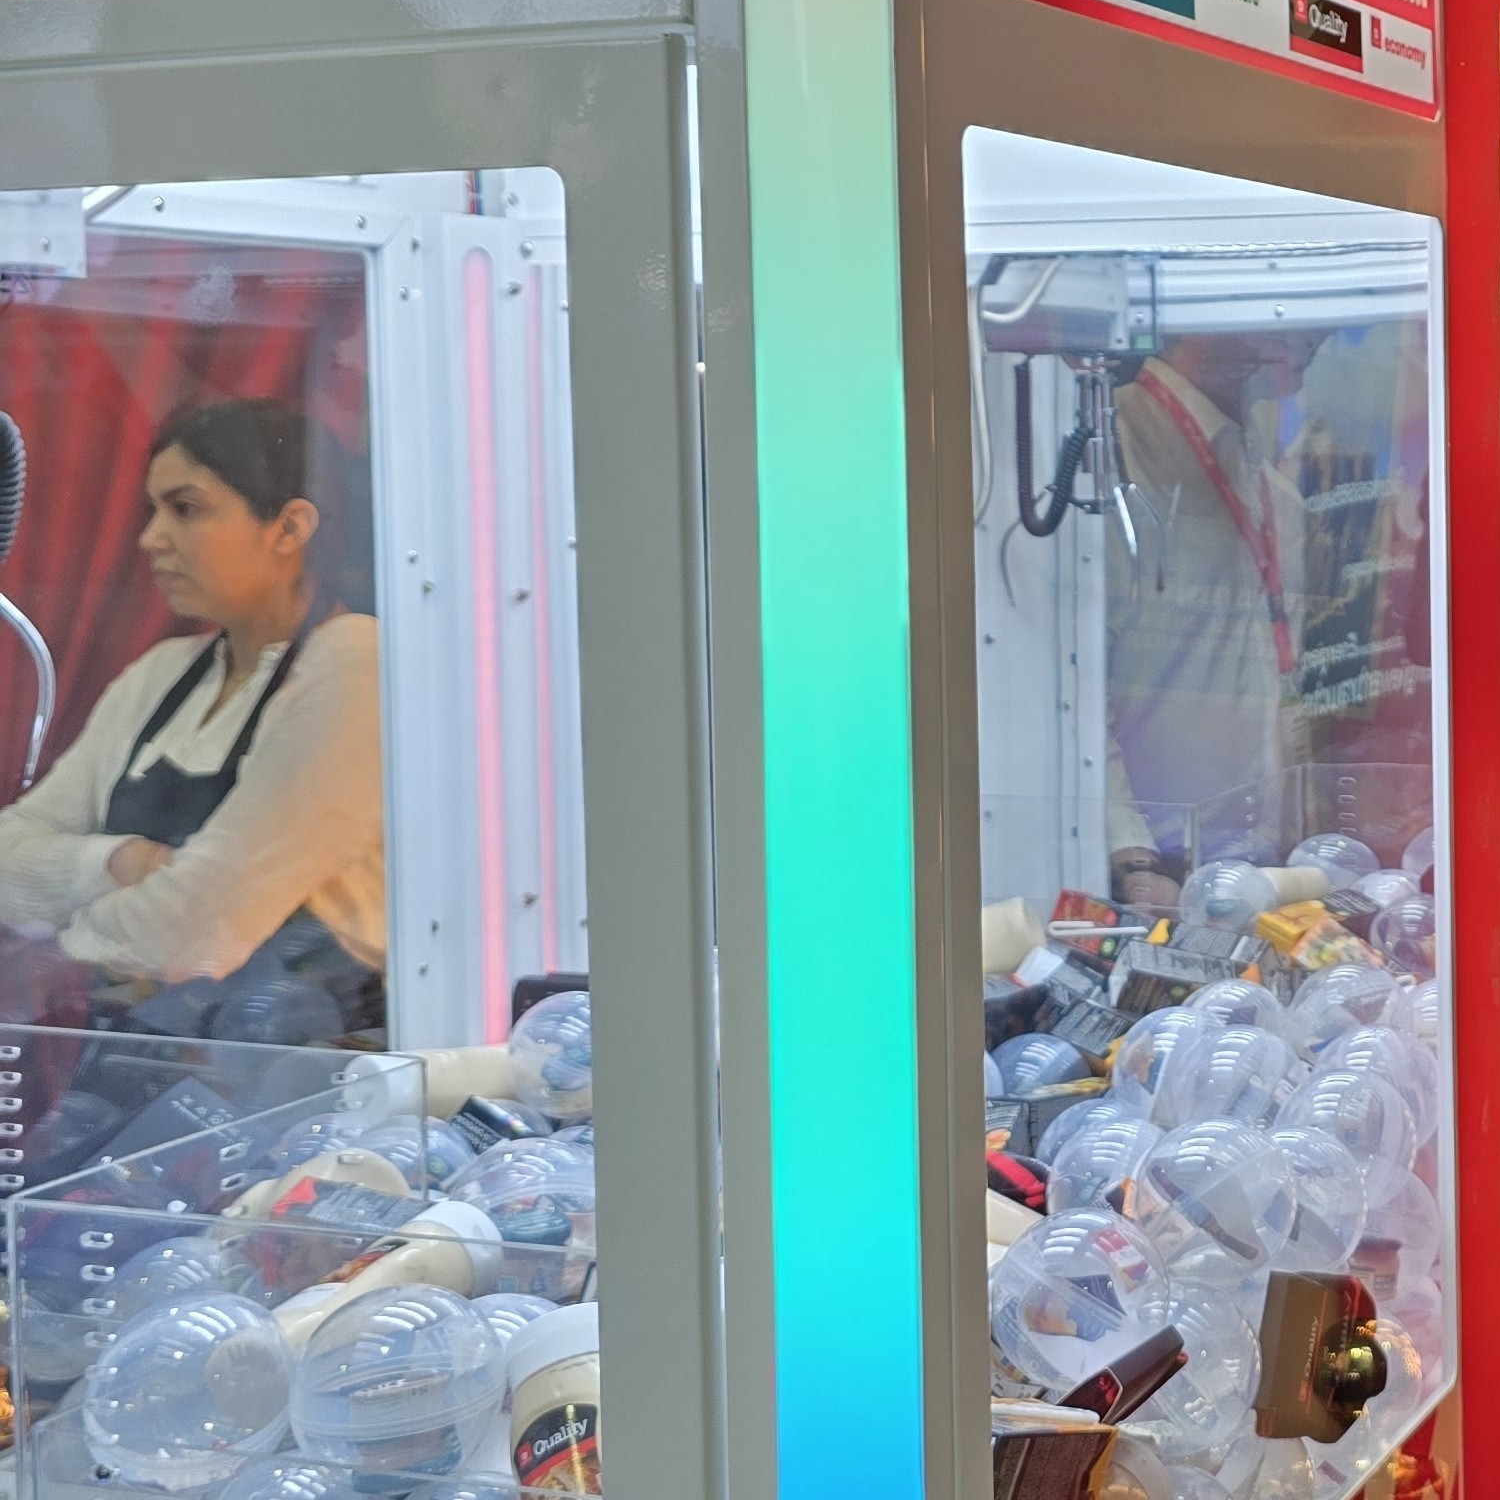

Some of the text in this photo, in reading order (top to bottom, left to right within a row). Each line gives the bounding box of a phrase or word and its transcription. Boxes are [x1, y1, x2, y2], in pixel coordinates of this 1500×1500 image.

[1308, 3, 1349, 44] Quality
[1384, 36, 1427, 70] economy
[532, 1418, 589, 1456] Quality
